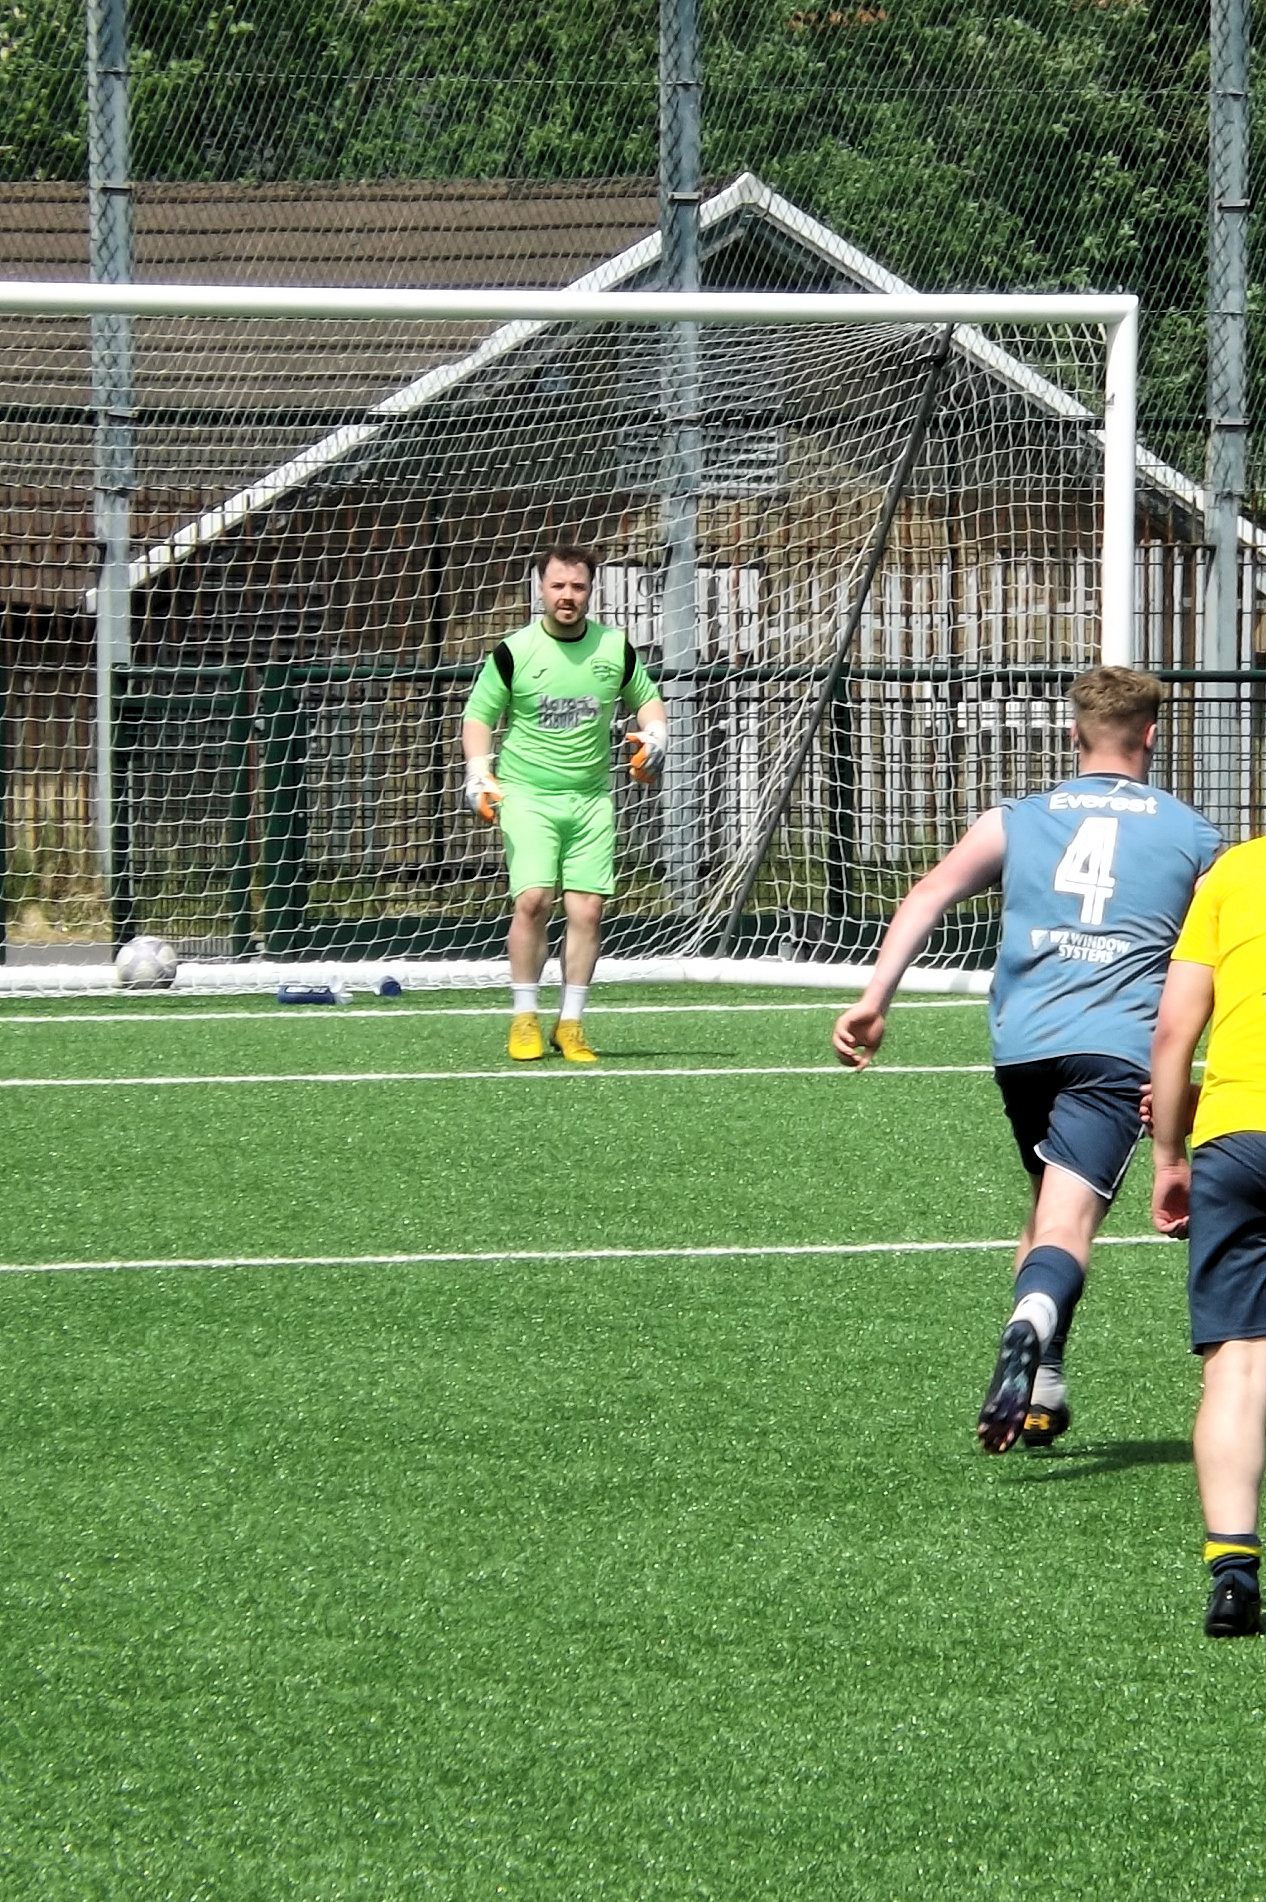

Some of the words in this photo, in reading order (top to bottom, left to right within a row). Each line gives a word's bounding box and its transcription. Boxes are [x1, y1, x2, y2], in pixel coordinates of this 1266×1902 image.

[1049, 792, 1158, 815] Everest
[1054, 816, 1119, 926] 4
[1058, 944, 1114, 964] SYSTEMS
[1070, 932, 1131, 954] WINDOW
